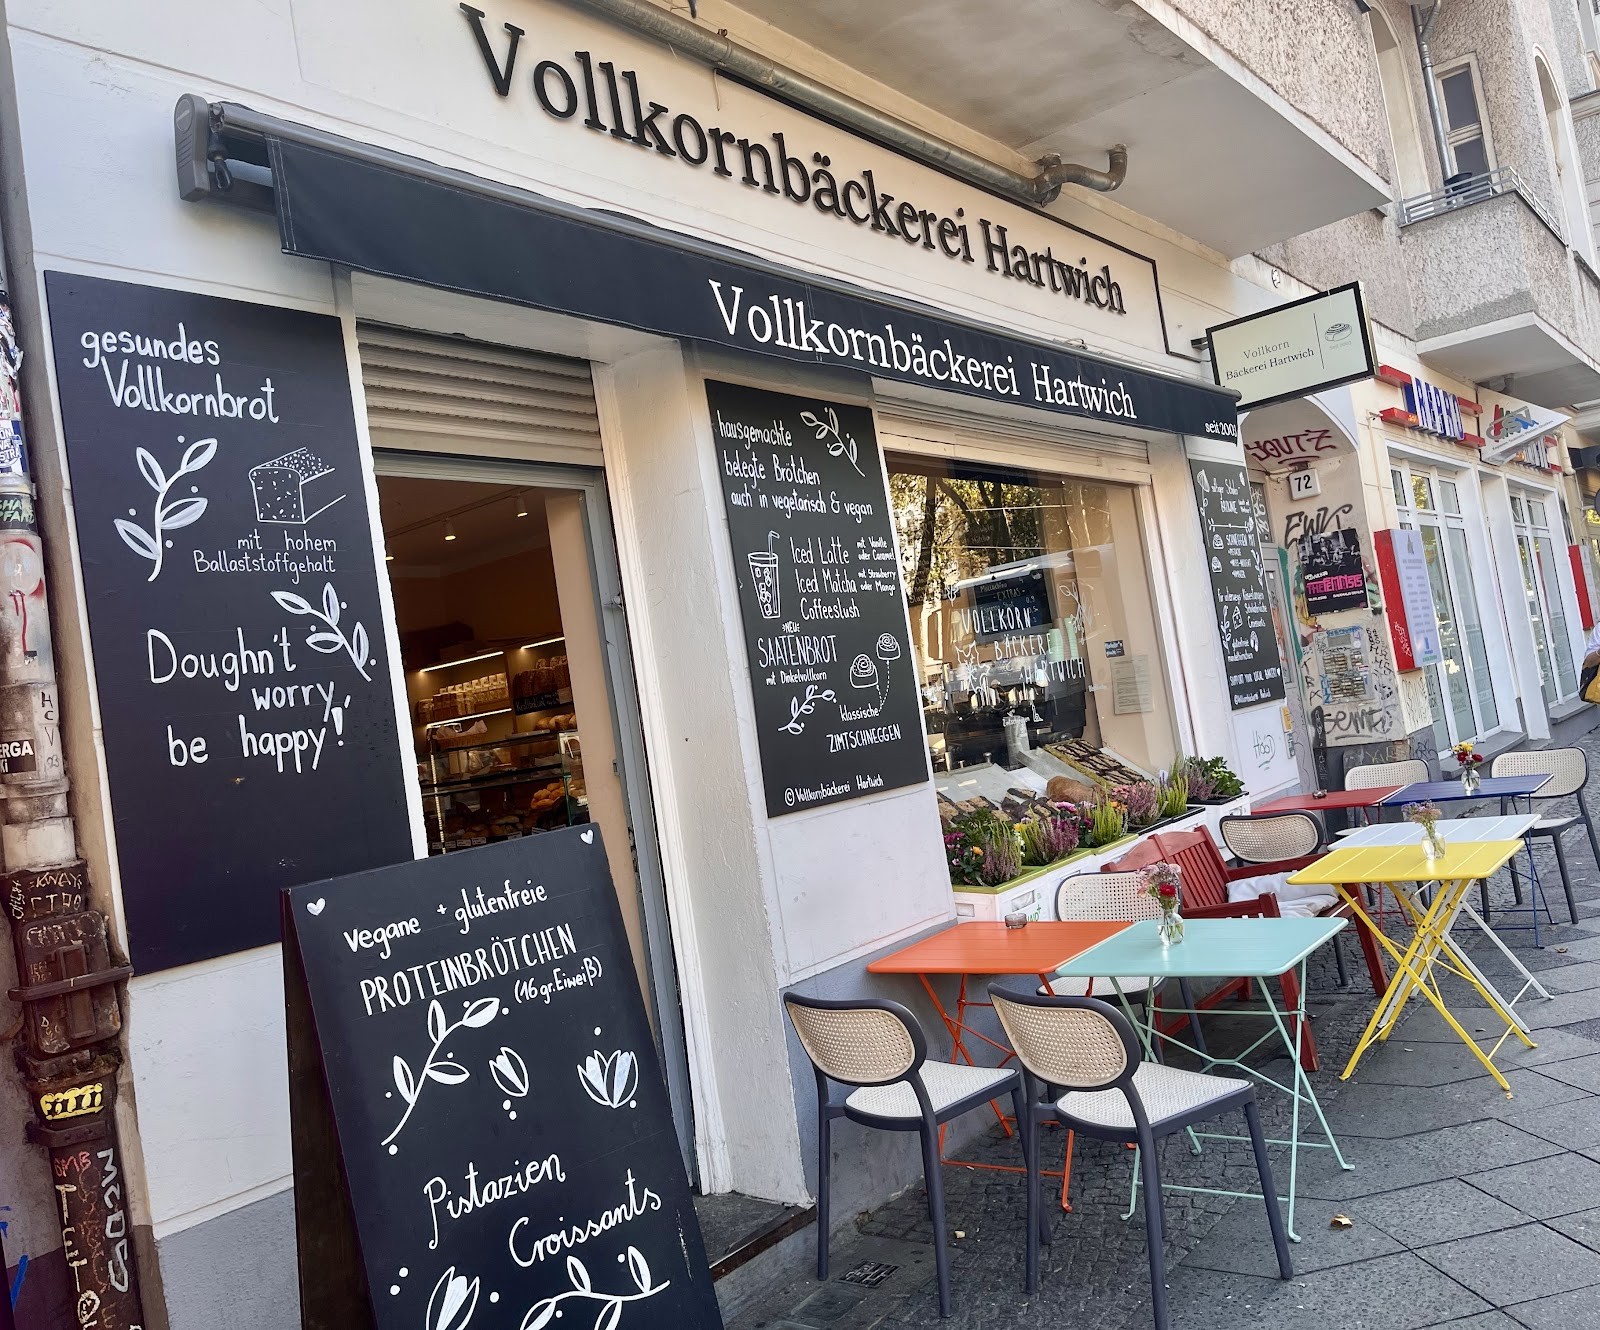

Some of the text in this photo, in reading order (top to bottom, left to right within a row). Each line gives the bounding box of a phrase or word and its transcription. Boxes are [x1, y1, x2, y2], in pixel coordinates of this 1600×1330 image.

[460, 2, 1127, 315] Vollkornbäckerei Hartwich
[80, 322, 220, 368] gesundes
[708, 278, 1137, 420] Vollkornbäckerei Hartwich
[1243, 341, 1291, 360] Vollkorn
[1225, 348, 1314, 381] Bäckerei Hartwich
[101, 356, 279, 423] Vollkornbrot
[716, 409, 792, 450] hausgemachte
[1205, 420, 1220, 434] seit
[724, 449, 821, 489] belegte Brötchen
[1294, 474, 1312, 492] 72
[731, 483, 873, 524] auch in vegetarisch & vegan
[238, 529, 337, 552] mit hohem
[789, 536, 850, 565] Iced Latte
[856, 535, 887, 548] mit Vanille
[858, 547, 896, 561] oder Caramel
[193, 549, 336, 584] Ballaststoffgehalt
[795, 568, 858, 593] Iced Matcha
[858, 568, 896, 581] mit Strawberry
[860, 580, 896, 596] oder Mango
[800, 597, 861, 620] Coffeeslush
[961, 606, 1032, 634] VOLLKORN
[147, 627, 297, 692] Doughn't
[758, 635, 837, 668] SAATENBROT
[766, 667, 828, 686] mit Dinkelvollkorn
[839, 702, 880, 722] klassische
[167, 707, 343, 773] be happy!
[826, 723, 902, 753] ZIMTSCHNEGGEN
[856, 774, 884, 790] Hartwich
[437, 903, 448, 915] +
[454, 879, 548, 934] glutenfreie
[359, 922, 577, 1016] PROTEINBRÖTCHEN
[424, 1153, 566, 1250] Pistazien
[508, 1168, 661, 1267] Croissants
